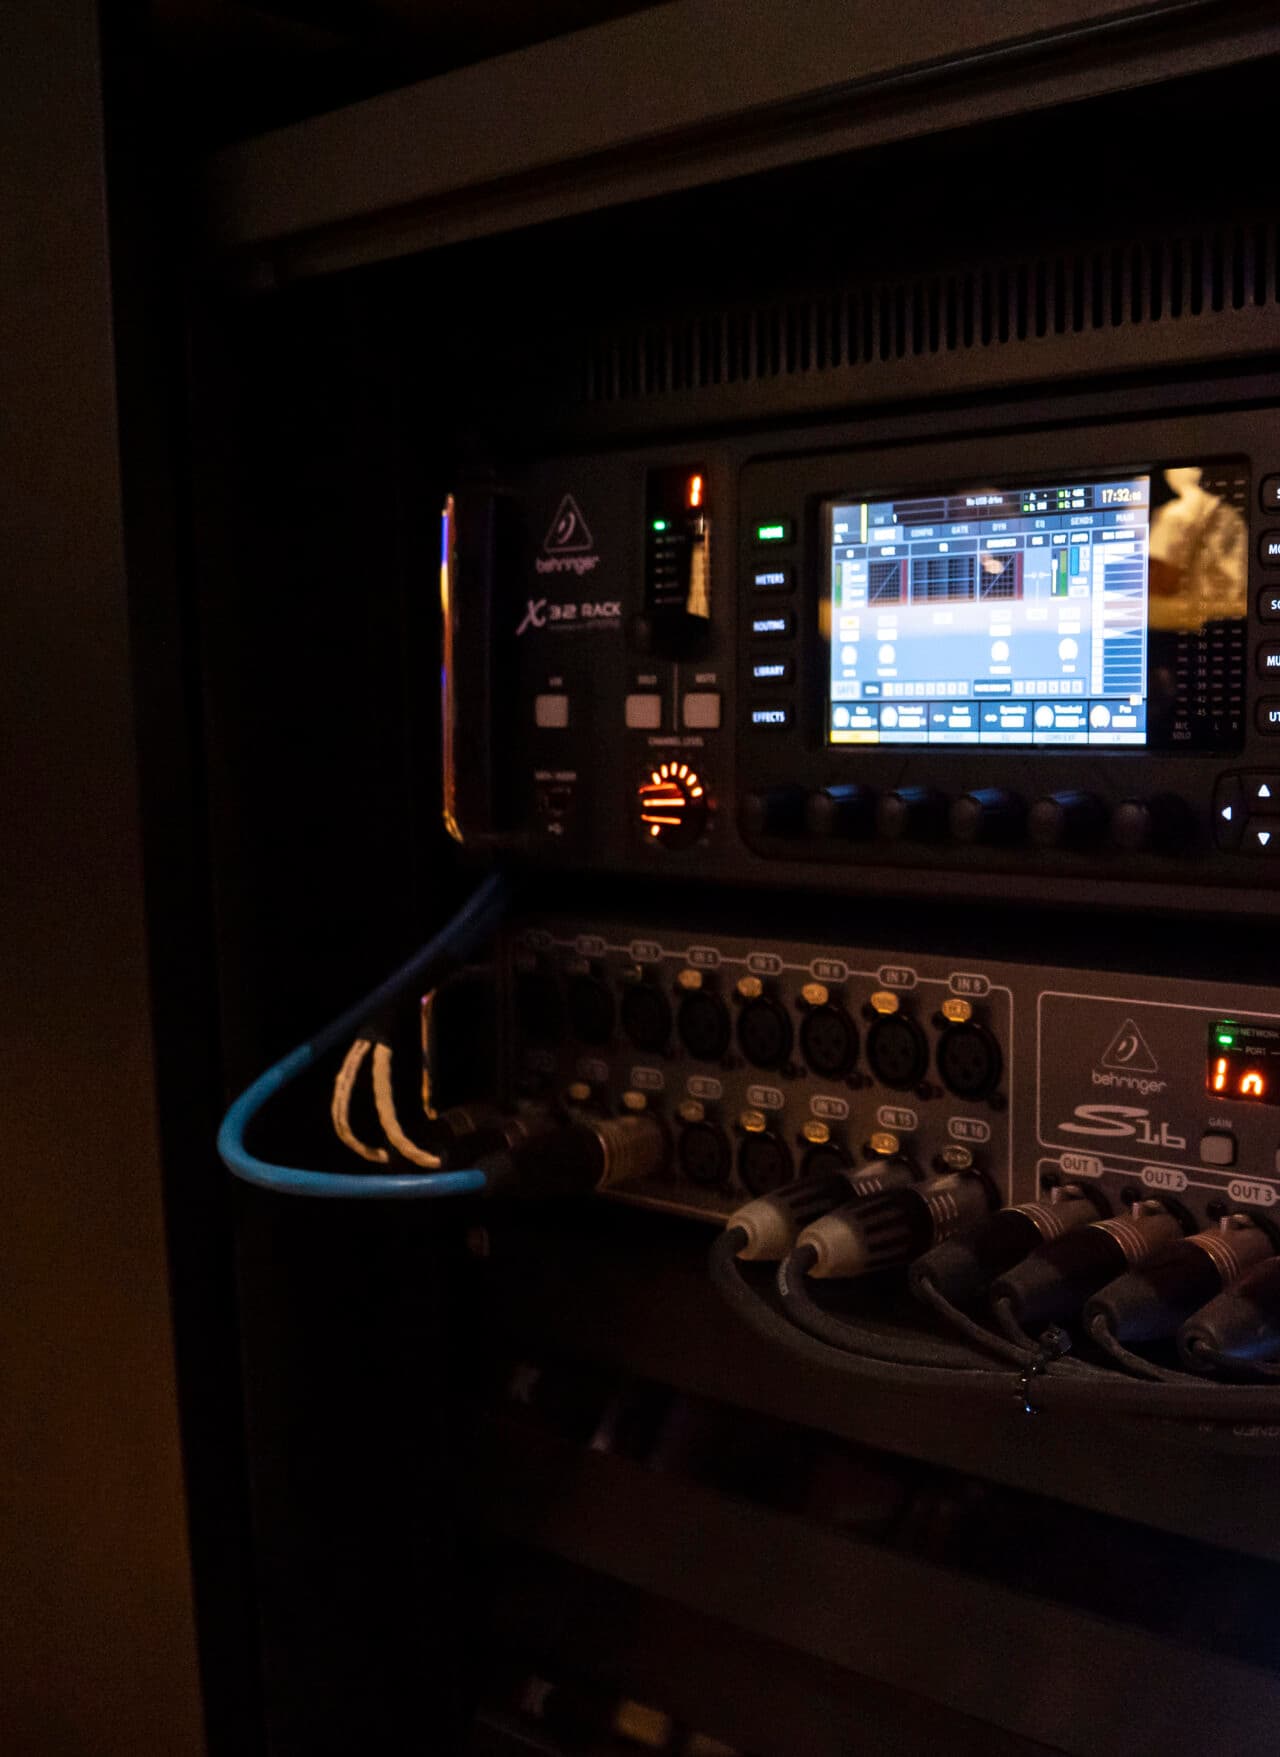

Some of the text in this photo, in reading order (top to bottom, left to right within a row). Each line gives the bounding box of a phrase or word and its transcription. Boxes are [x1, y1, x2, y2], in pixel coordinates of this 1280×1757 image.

[581, 601, 622, 617] RACK
[886, 972, 909, 985] IN 7
[957, 979, 971, 991] IN
[1092, 1068, 1167, 1095] behringer
[1209, 1118, 1232, 1129] GAIN
[1063, 1157, 1090, 1170] OUT
[1144, 1170, 1184, 1187] OUT 2
[1231, 1184, 1273, 1201] OUT 3
